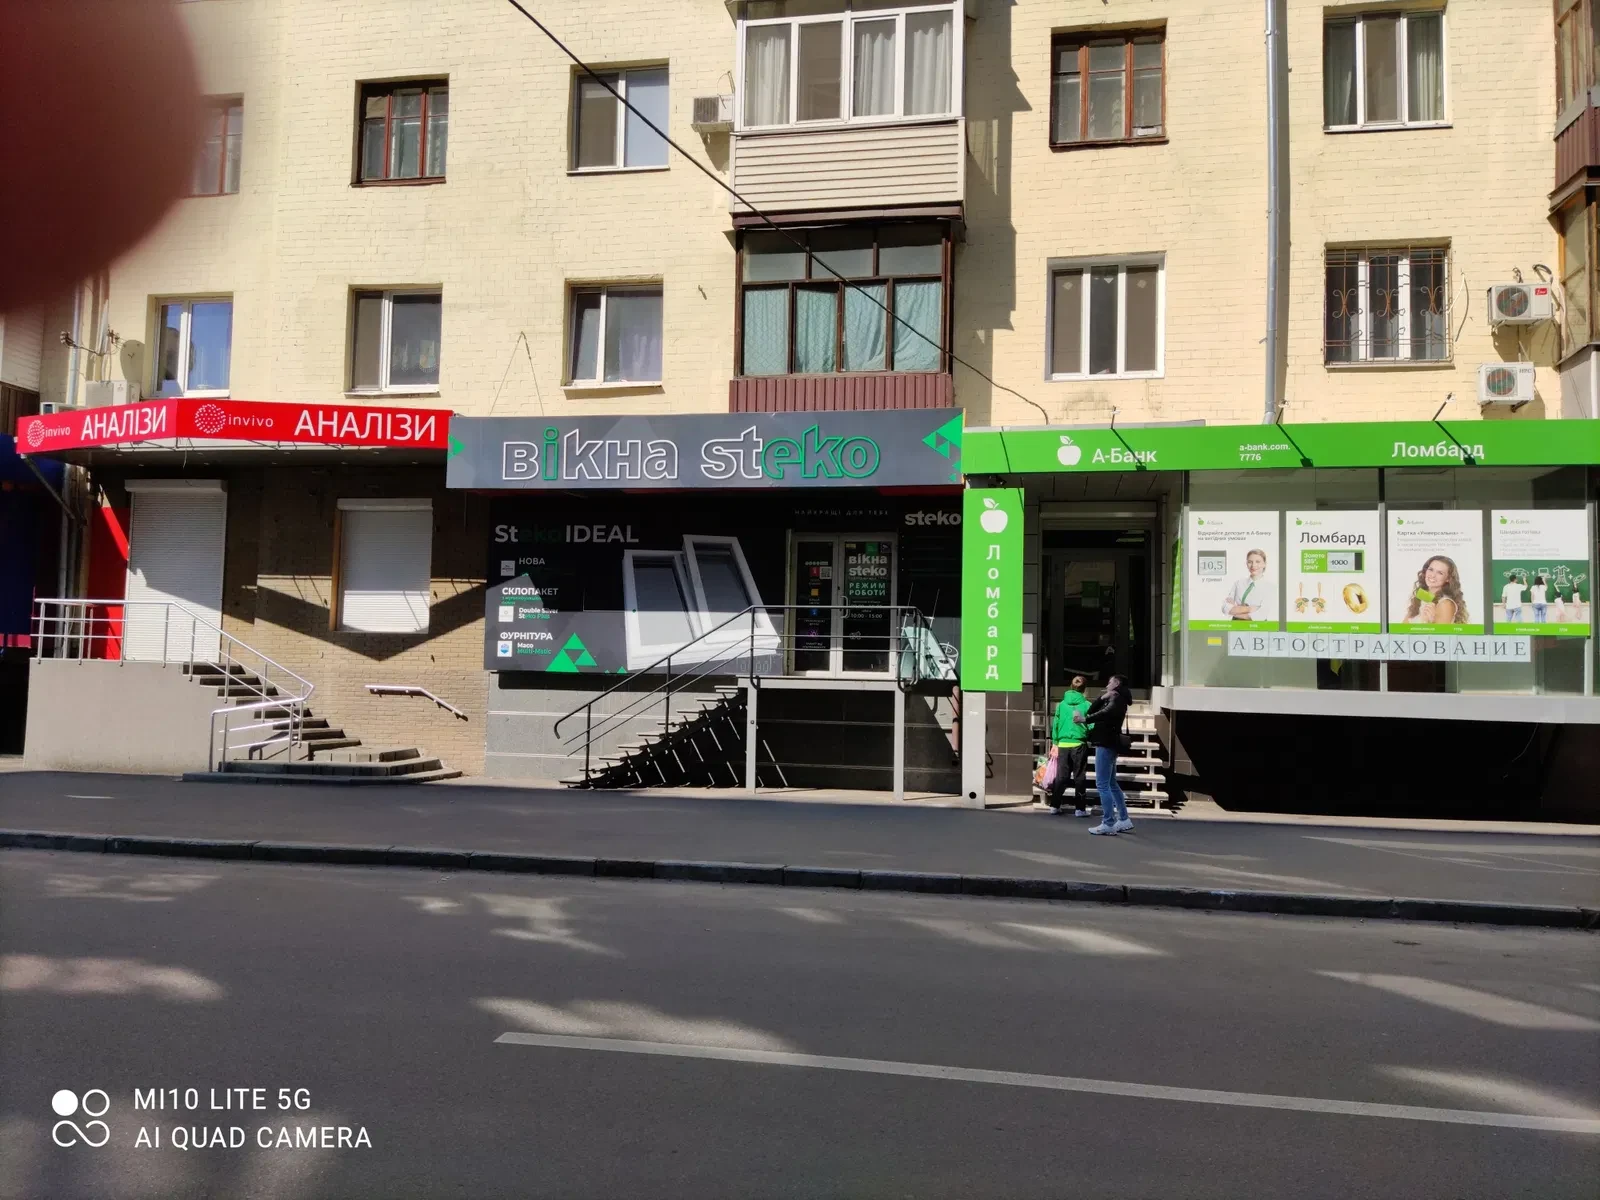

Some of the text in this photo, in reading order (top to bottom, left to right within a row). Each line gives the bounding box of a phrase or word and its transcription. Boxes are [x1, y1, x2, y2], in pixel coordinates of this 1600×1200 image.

[81, 405, 166, 441] АНАЛІЗИ
[228, 414, 274, 428] invivo
[294, 409, 436, 442] АНАЛІЗИ
[45, 425, 71, 438] invivo
[502, 425, 880, 482] вікна steko
[1092, 448, 1158, 464] А-Банк
[1239, 453, 1262, 461] 7776
[1391, 440, 1485, 461] Ломбард
[904, 510, 961, 526] steko
[565, 524, 640, 543] IDEAL
[1299, 531, 1366, 546] Ломбард
[519, 557, 546, 565] НОВА
[848, 553, 888, 565] вікна
[1202, 560, 1223, 572] 10,5
[848, 565, 888, 577] steko
[502, 587, 559, 596] СКЛОПАКЕТ
[985, 544, 1001, 681] Ломбард
[500, 631, 554, 641] ФУРНІТУРА
[1232, 636, 1527, 658] АВТОСТРАХОВАНИЕ
